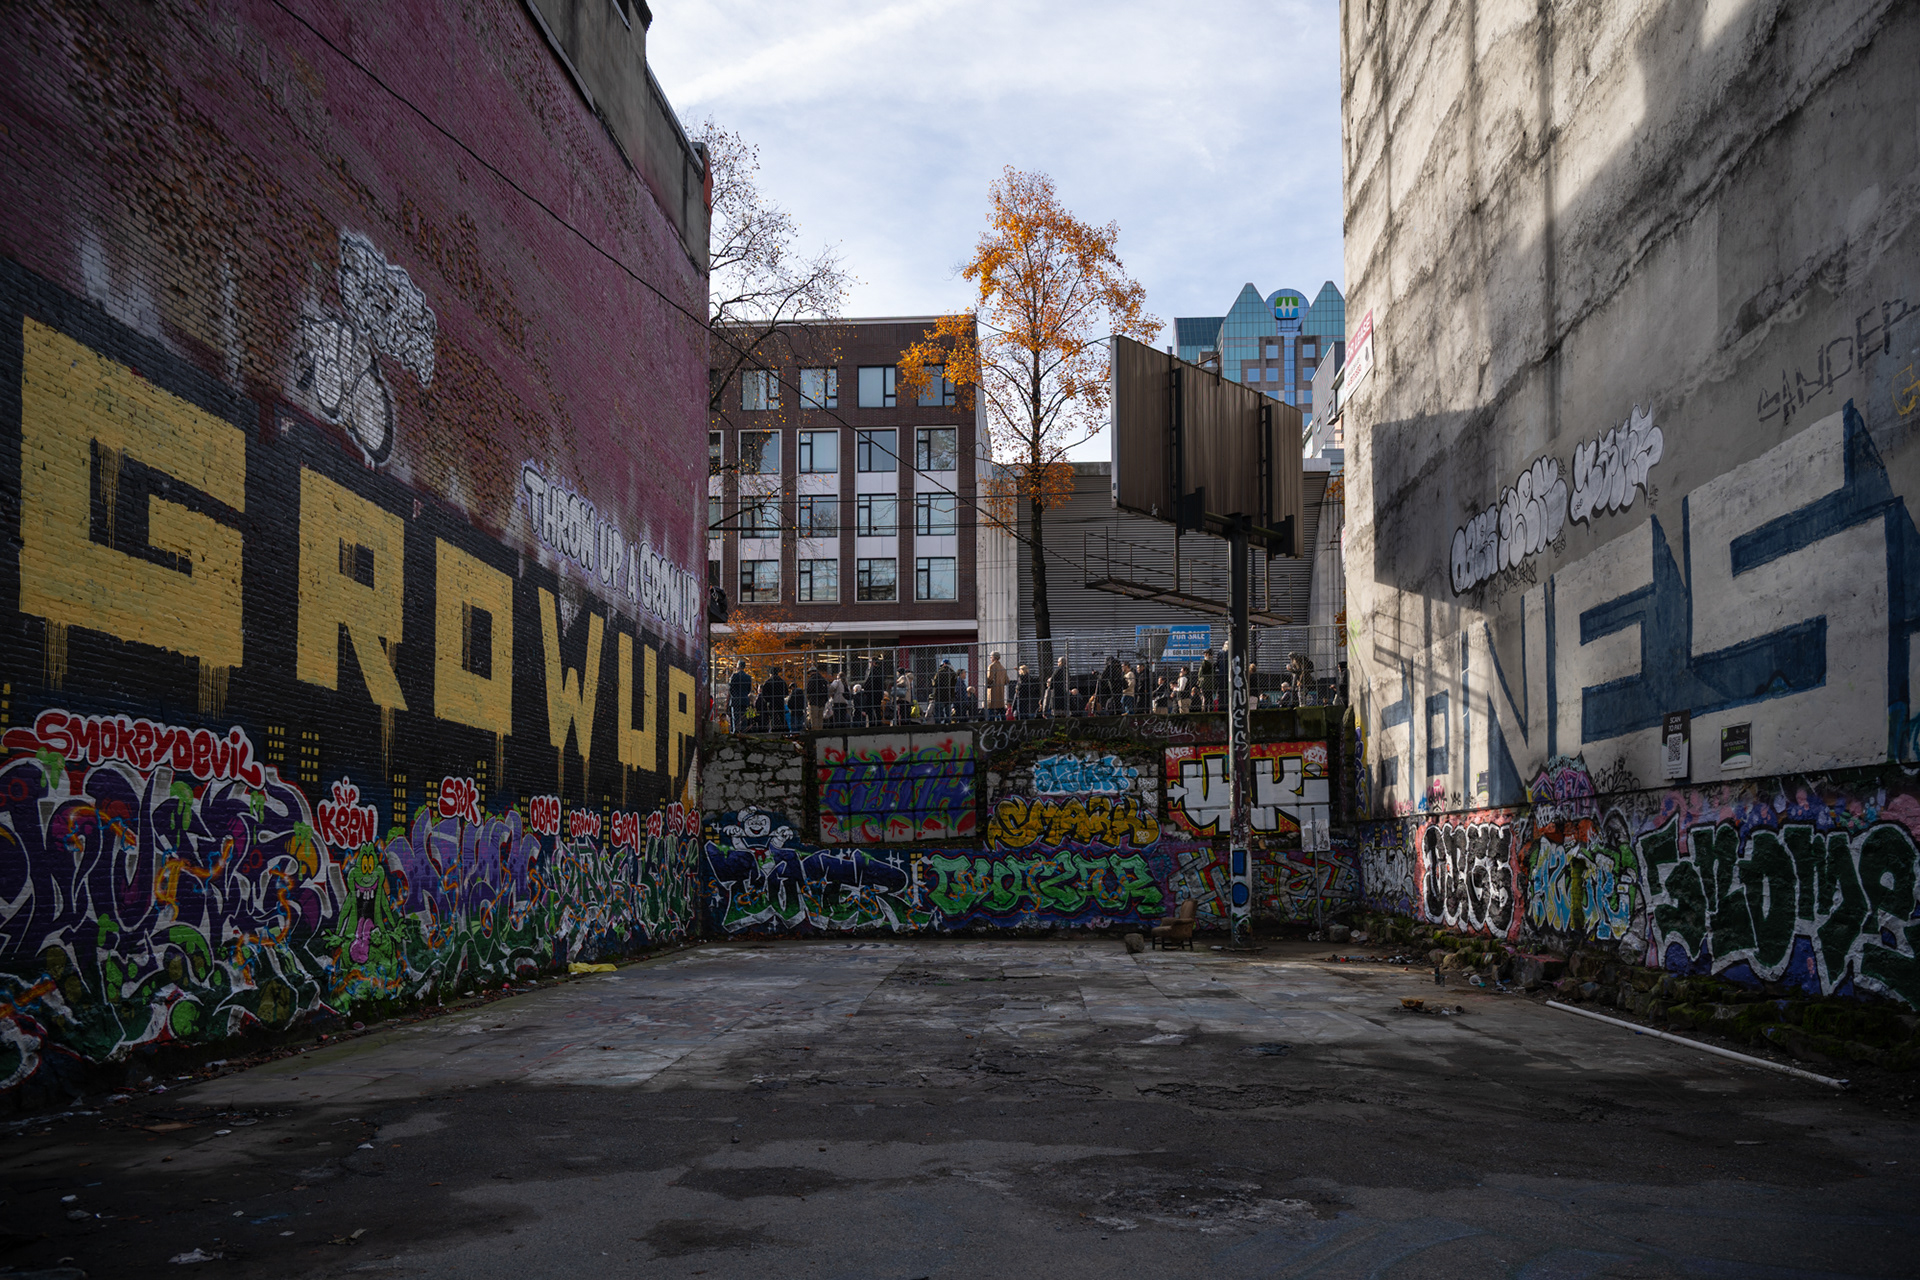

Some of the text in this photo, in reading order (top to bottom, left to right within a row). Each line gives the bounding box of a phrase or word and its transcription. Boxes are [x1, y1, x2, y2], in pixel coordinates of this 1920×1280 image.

[523, 465, 596, 571] THROW
[598, 521, 623, 590] UP
[627, 542, 637, 606] A
[1172, 630, 1206, 640] FOR SALE
[1669, 715, 1682, 724] SCAN
